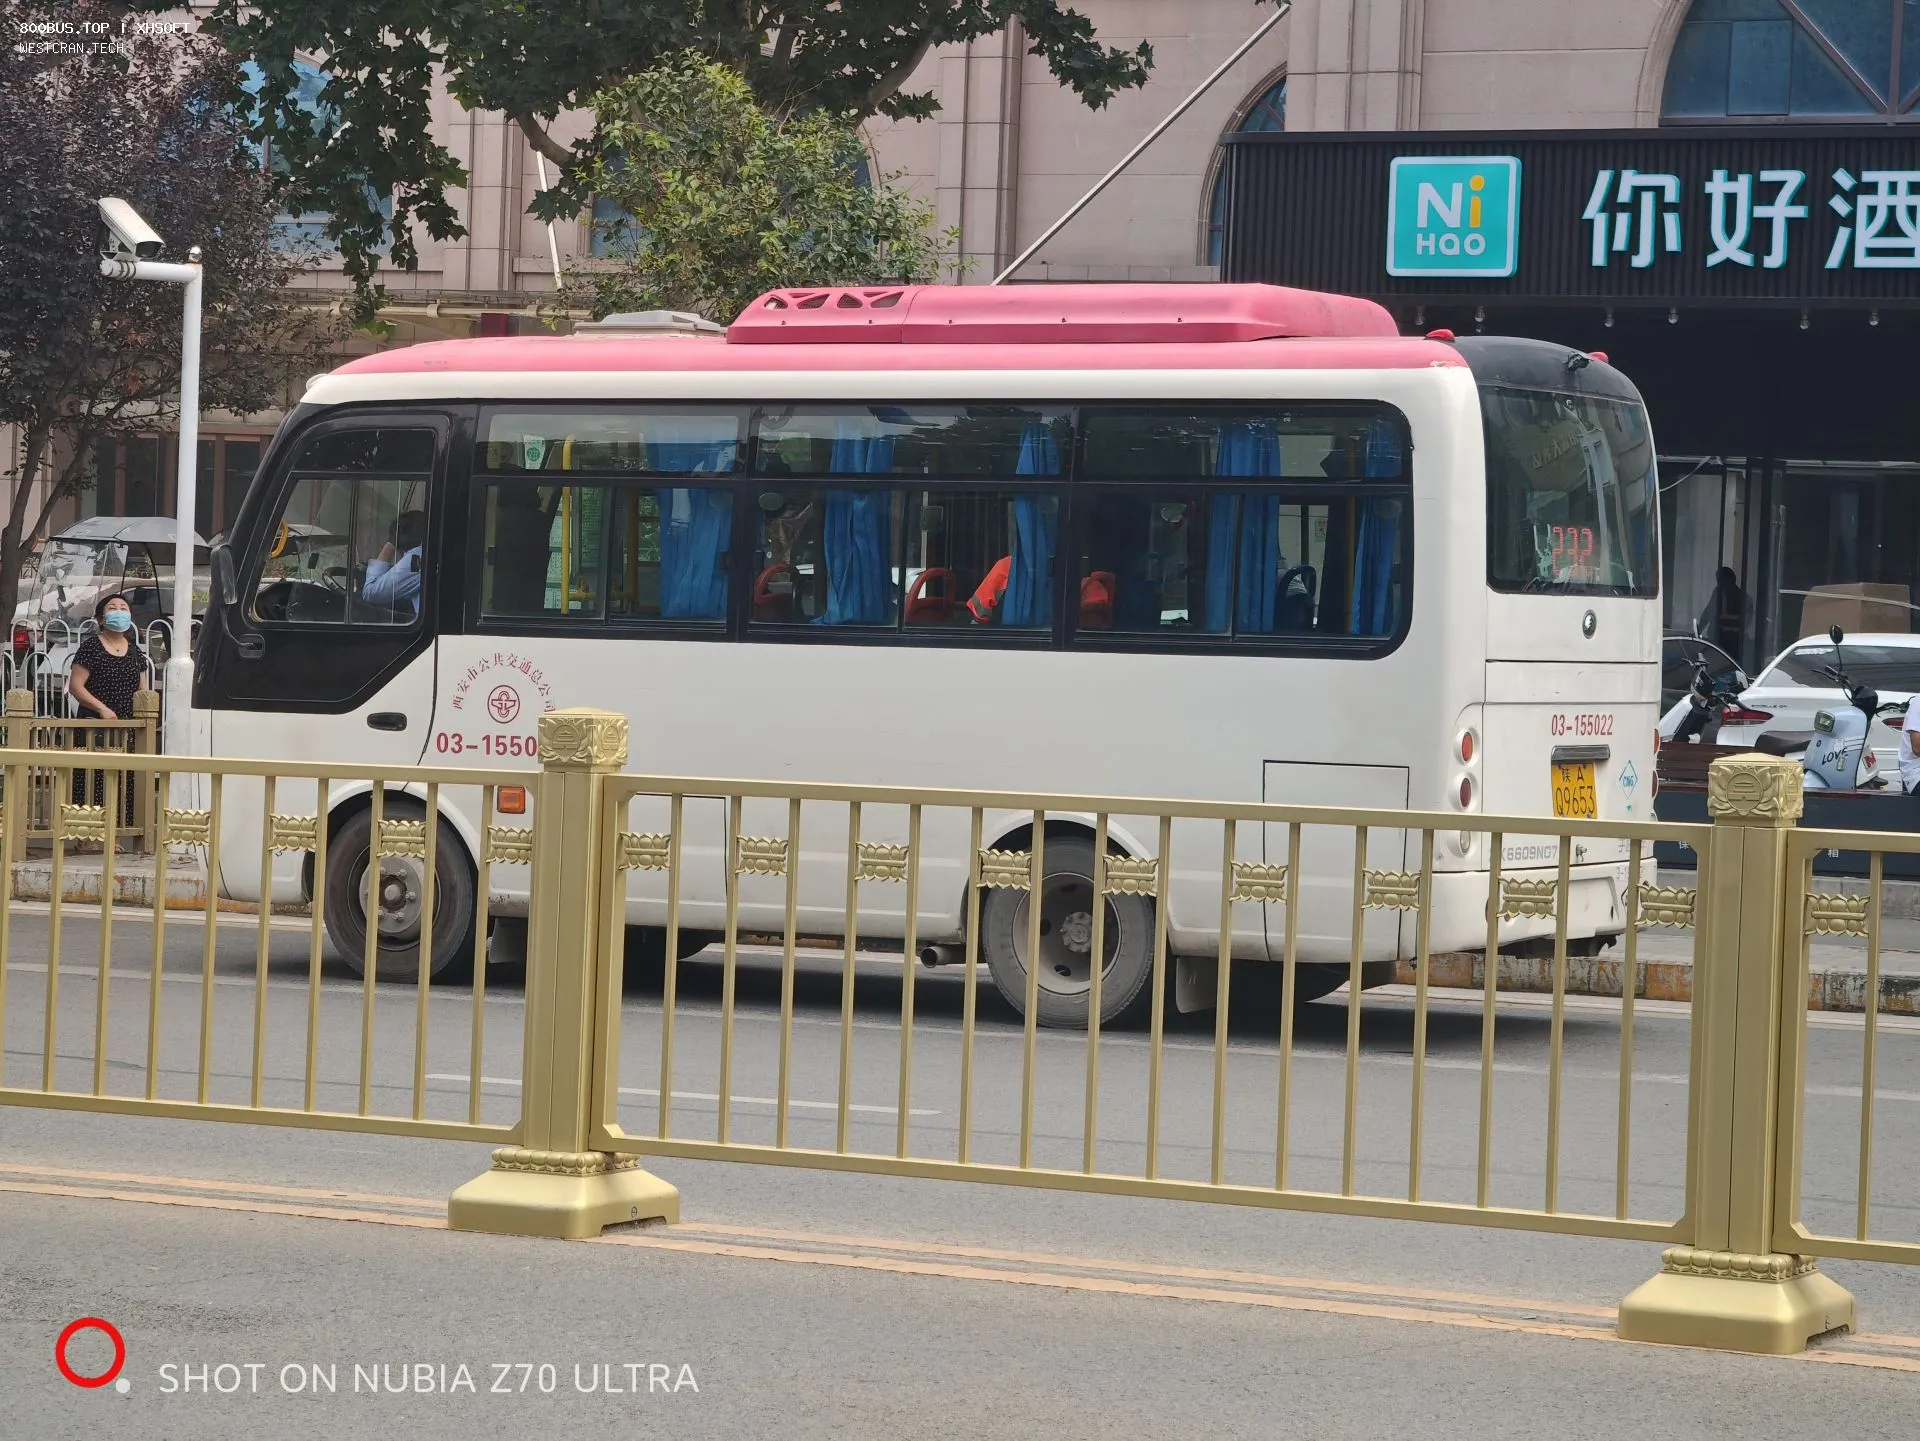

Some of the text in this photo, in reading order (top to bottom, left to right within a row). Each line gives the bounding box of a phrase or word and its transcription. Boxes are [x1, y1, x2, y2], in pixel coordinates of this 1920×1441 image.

[1416, 174, 1486, 229] Ni
[1581, 167, 1920, 269] 你好酒
[452, 652, 556, 713] 西安市公共交通总公司
[1551, 713, 1614, 736] 03-155022
[1821, 747, 1849, 766] LOVE
[1555, 785, 1595, 816] Q9653
